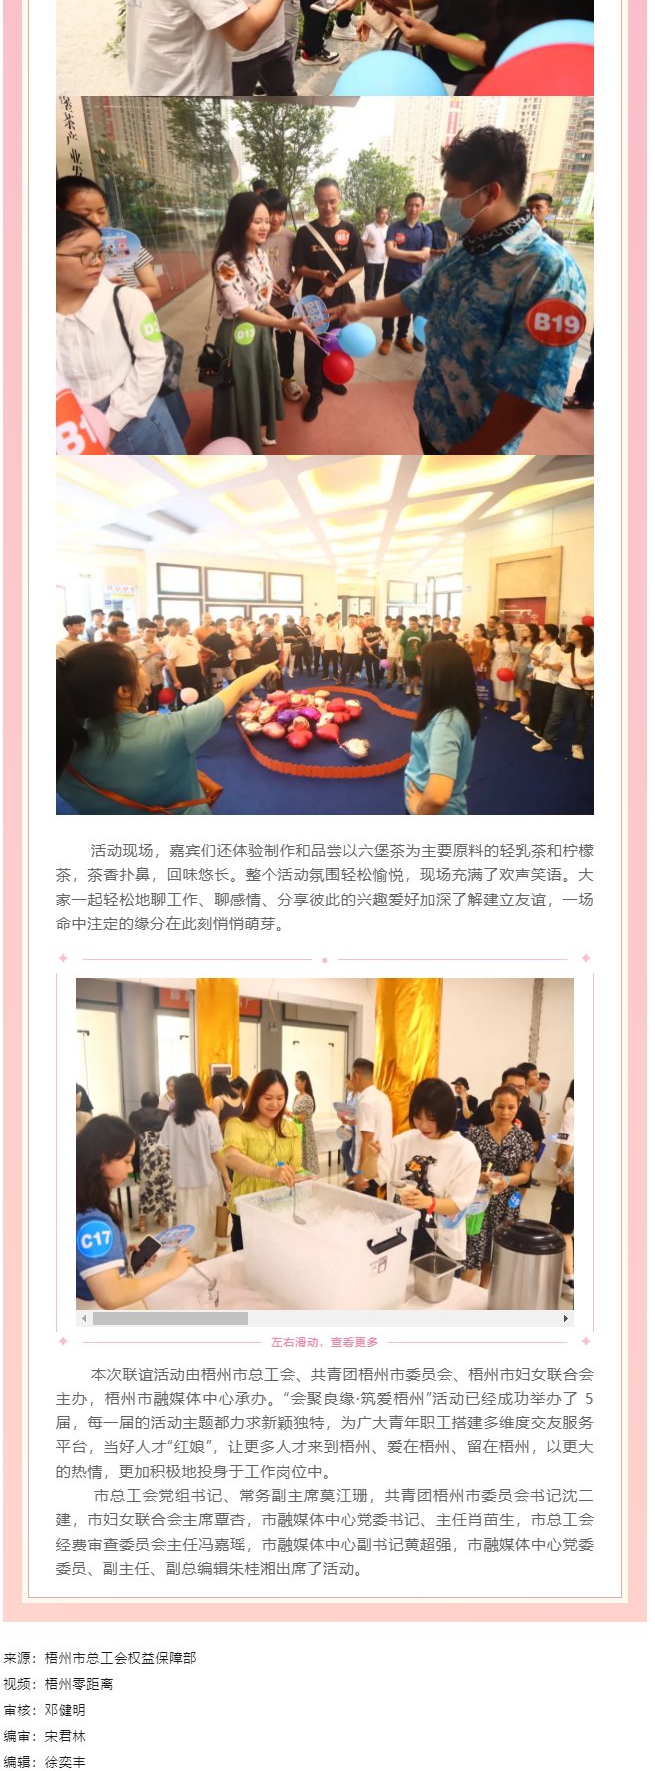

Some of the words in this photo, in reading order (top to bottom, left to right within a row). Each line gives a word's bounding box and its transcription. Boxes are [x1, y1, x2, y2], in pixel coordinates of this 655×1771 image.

[534, 312, 580, 335] B19
[237, 328, 255, 340] D13
[90, 843, 594, 860] 活动现场，嘉宾们还体验制作和品尝以六堡茶为主要原料的轻乳茶和柠檬
[55, 866, 594, 883] 茶，茶香扑鼻，回味悠长。整个活动氛围轻松愉悦，现场充满了欢声笑语。大
[55, 892, 594, 908] 家一起轻松地聊工作、聊感情、分享彼此的兴趣爱好加深了解建立友谊，一场
[55, 915, 282, 932] 命中注定的缘分在此刻悄悄萌芽。
[81, 1230, 111, 1249] C17
[270, 1336, 379, 1348] 左右滑动，查看更多
[90, 1366, 595, 1383] 本次联谊活动由梧州市总工会、共青团梧州市委员会、梧州市妇女联合会
[585, 1393, 594, 1405] 5
[55, 1414, 594, 1431] 届，每一届的活动主题都力求新颖独特，为广大青年职工搭建多维度交友服务
[56, 1464, 329, 1480] 的热情，更加积极地投身于工作岗位中。
[93, 1487, 594, 1504] 市总工会党组书记、常务副主席莫江珊，共青团梧州市委员会书记沈二
[55, 1511, 595, 1528] 建，市妇女联合会主席覃杏，市融媒体中心党委书记、主任肖苗生，市总工会
[55, 1536, 595, 1553] 经费审查委员会主任冯嘉瑶，市融媒体中心副书记黄超强，市融媒体中心党委
[55, 1561, 360, 1577] 委员、副主任、副总编辑朱桂湘出席了活动。
[3, 1651, 197, 1665] 来源：梧州市总工会权益保障部
[3, 1677, 114, 1691] 视频：梧州零距离
[3, 1703, 86, 1717] 审核：邓健明
[3, 1729, 86, 1743] 编审：宋君林
[3, 1755, 86, 1769] 编辑：徐奕丰
